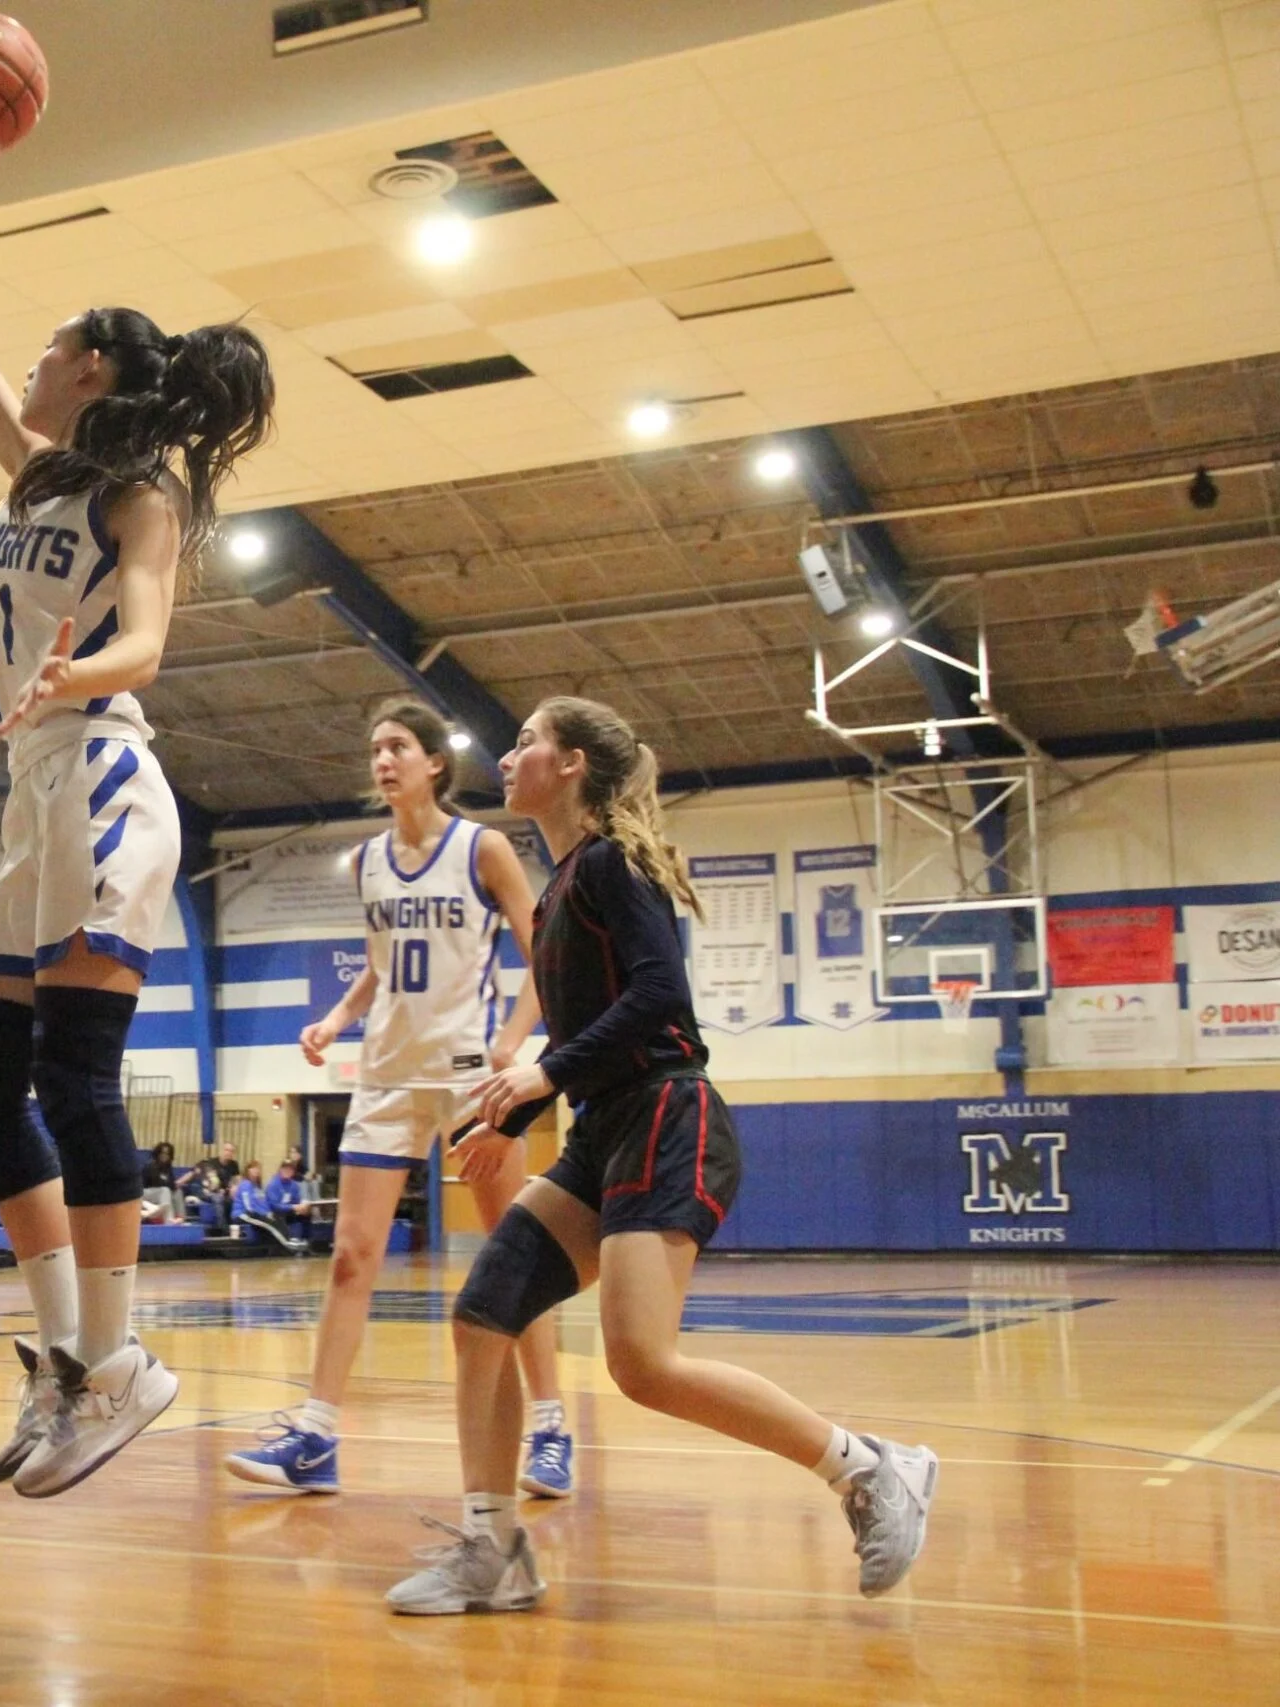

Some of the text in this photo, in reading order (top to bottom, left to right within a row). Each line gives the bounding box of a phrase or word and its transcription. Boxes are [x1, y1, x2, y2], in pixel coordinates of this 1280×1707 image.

[365, 896, 465, 932] KNIGHTS
[390, 939, 429, 993] 10
[970, 1227, 1065, 1243] KNIGHTS
